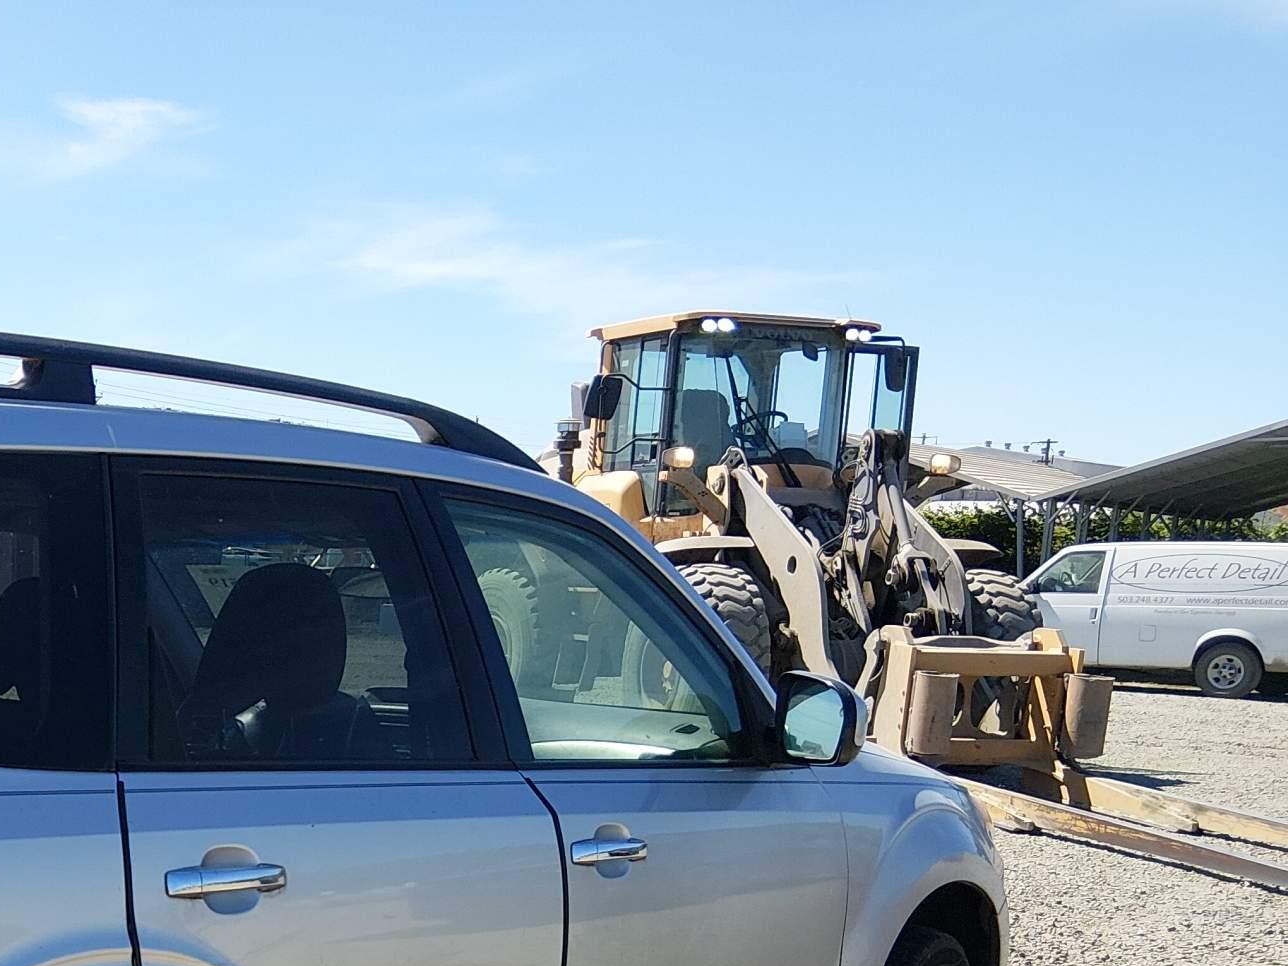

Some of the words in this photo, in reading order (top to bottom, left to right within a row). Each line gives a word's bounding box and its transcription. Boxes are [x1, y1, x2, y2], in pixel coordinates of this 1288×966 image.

[1118, 562, 1138, 579] A
[1145, 558, 1219, 579] Perfect
[1221, 560, 1288, 581] Detail
[1186, 597, 1288, 606] www.aperfectdetail.co
